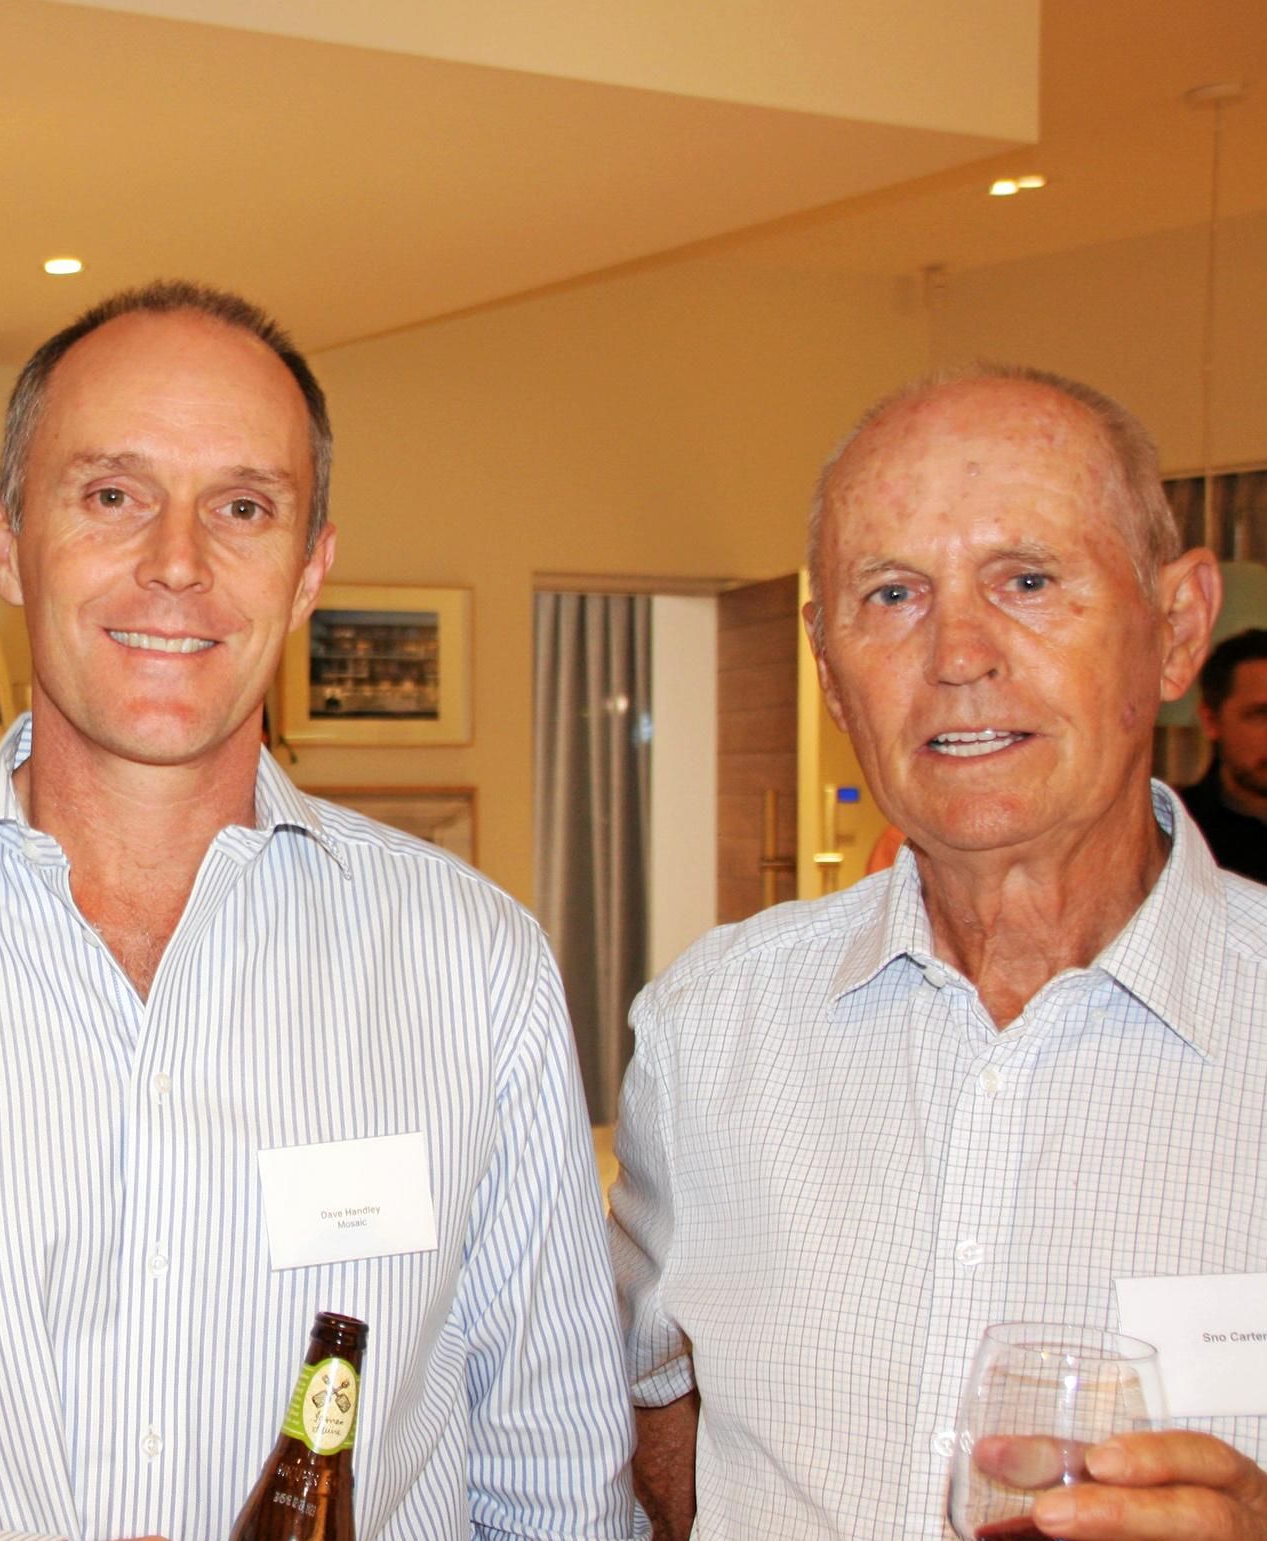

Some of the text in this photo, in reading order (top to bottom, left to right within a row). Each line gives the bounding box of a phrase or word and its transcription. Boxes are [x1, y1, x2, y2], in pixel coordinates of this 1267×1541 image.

[320, 1205, 381, 1220] Dave Handley
[337, 1218, 368, 1229] Mosaic
[1202, 1331, 1267, 1343] Sno Carter
